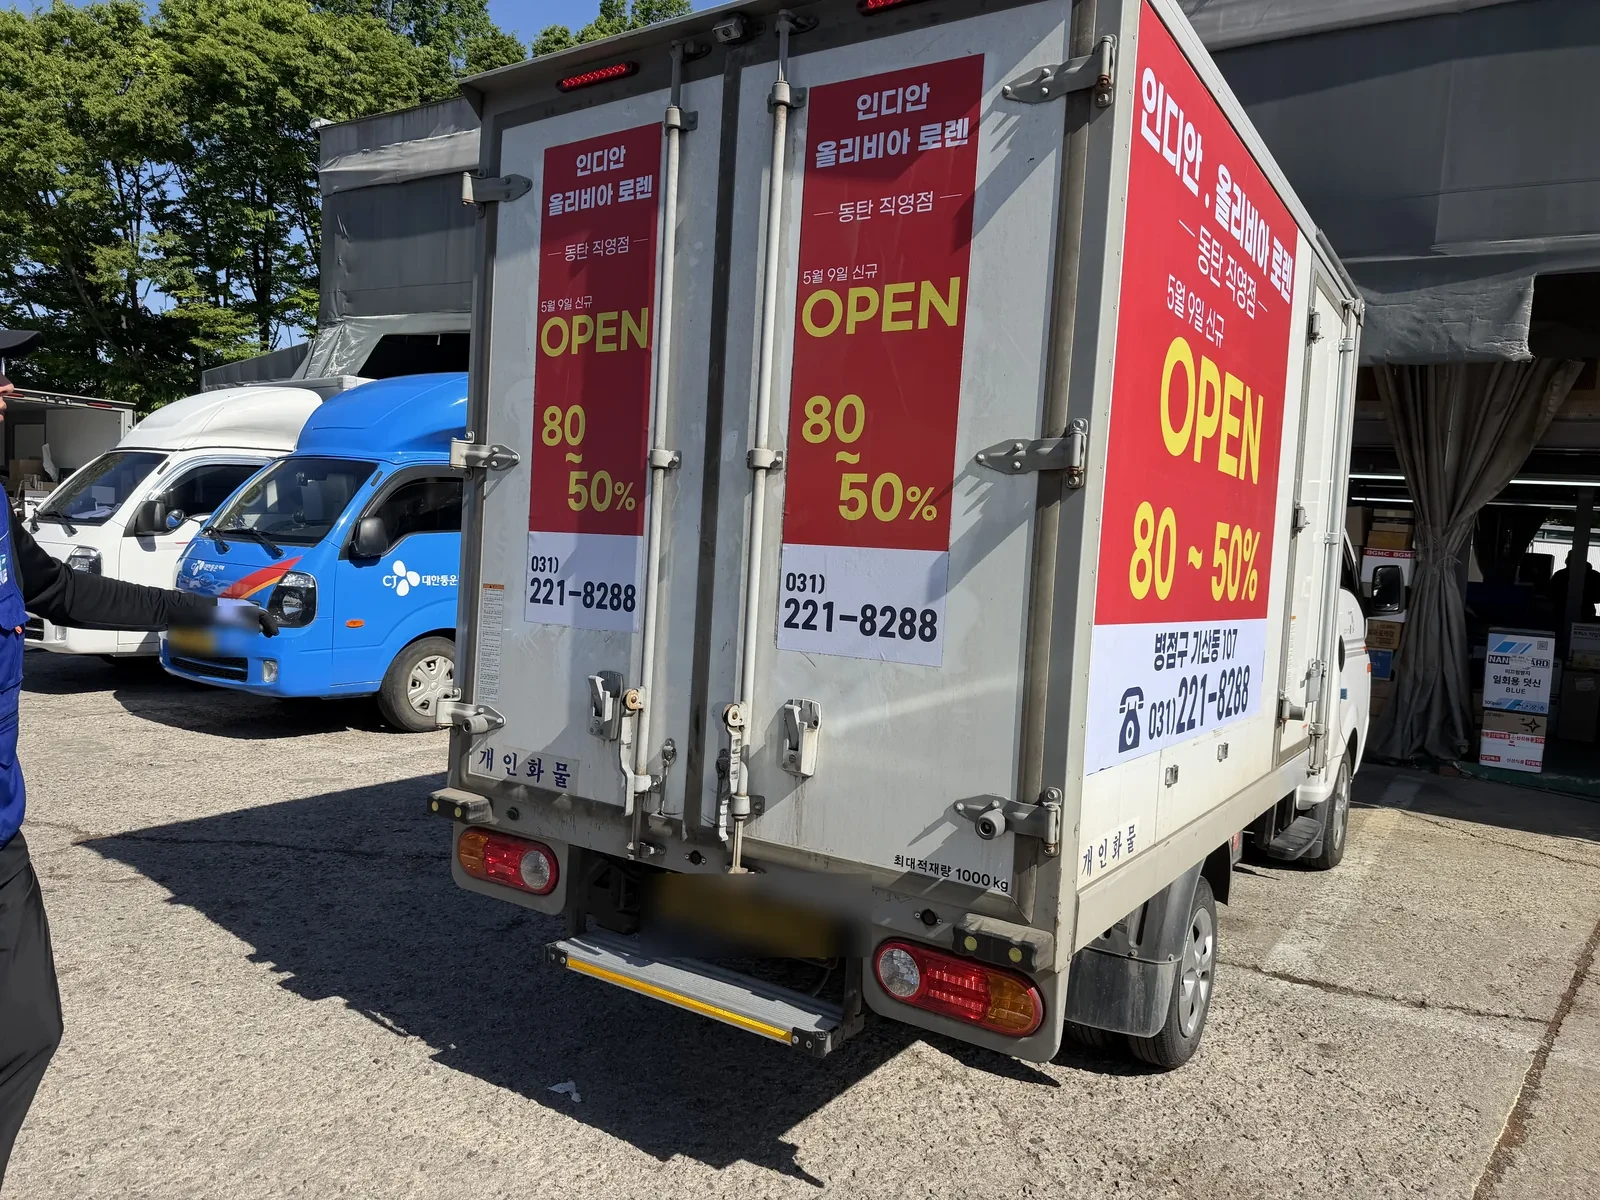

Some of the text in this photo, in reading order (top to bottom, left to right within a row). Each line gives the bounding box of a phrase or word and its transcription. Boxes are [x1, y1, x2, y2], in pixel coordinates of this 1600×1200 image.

[856, 82, 930, 121] 인디안
[576, 145, 626, 177] 인디안
[815, 117, 970, 169] 올리비아 로렌
[548, 174, 653, 217] 올리비아 로렌
[838, 190, 934, 223] 동탄 직영점
[564, 236, 630, 262] 동탄 직영점
[1214, 164, 1269, 276] 올리비아
[1270, 236, 1293, 304] 로렌
[803, 263, 878, 285] 5월 9일 신규
[1198, 224, 1257, 320] 동탄 직영점
[540, 296, 593, 313] 5월 9일 신규
[801, 276, 961, 338] OPEN
[1166, 273, 1225, 349] 5월 9일 신규
[540, 307, 649, 358] OPEN
[541, 404, 586, 447] 80
[801, 394, 866, 444] 80
[1160, 336, 1264, 485] OPEN
[567, 469, 636, 512] 50%
[838, 472, 938, 522] 50%
[531, 555, 559, 574] 031)
[1129, 500, 1177, 601] 80
[1211, 521, 1261, 602] 50%
[1392, 551, 1411, 559] BGM
[382, 574, 460, 589] CJ 대한통운
[529, 577, 636, 613] 221-8288
[785, 572, 825, 594] 031)
[783, 598, 938, 642] 221-8288
[1153, 628, 1238, 672] 병점구 기산동 107
[1488, 655, 1509, 665] NAN
[1492, 674, 1541, 688] 일회용 덧신
[1505, 686, 1526, 695] BLUE
[893, 854, 952, 878] 최대적재량
